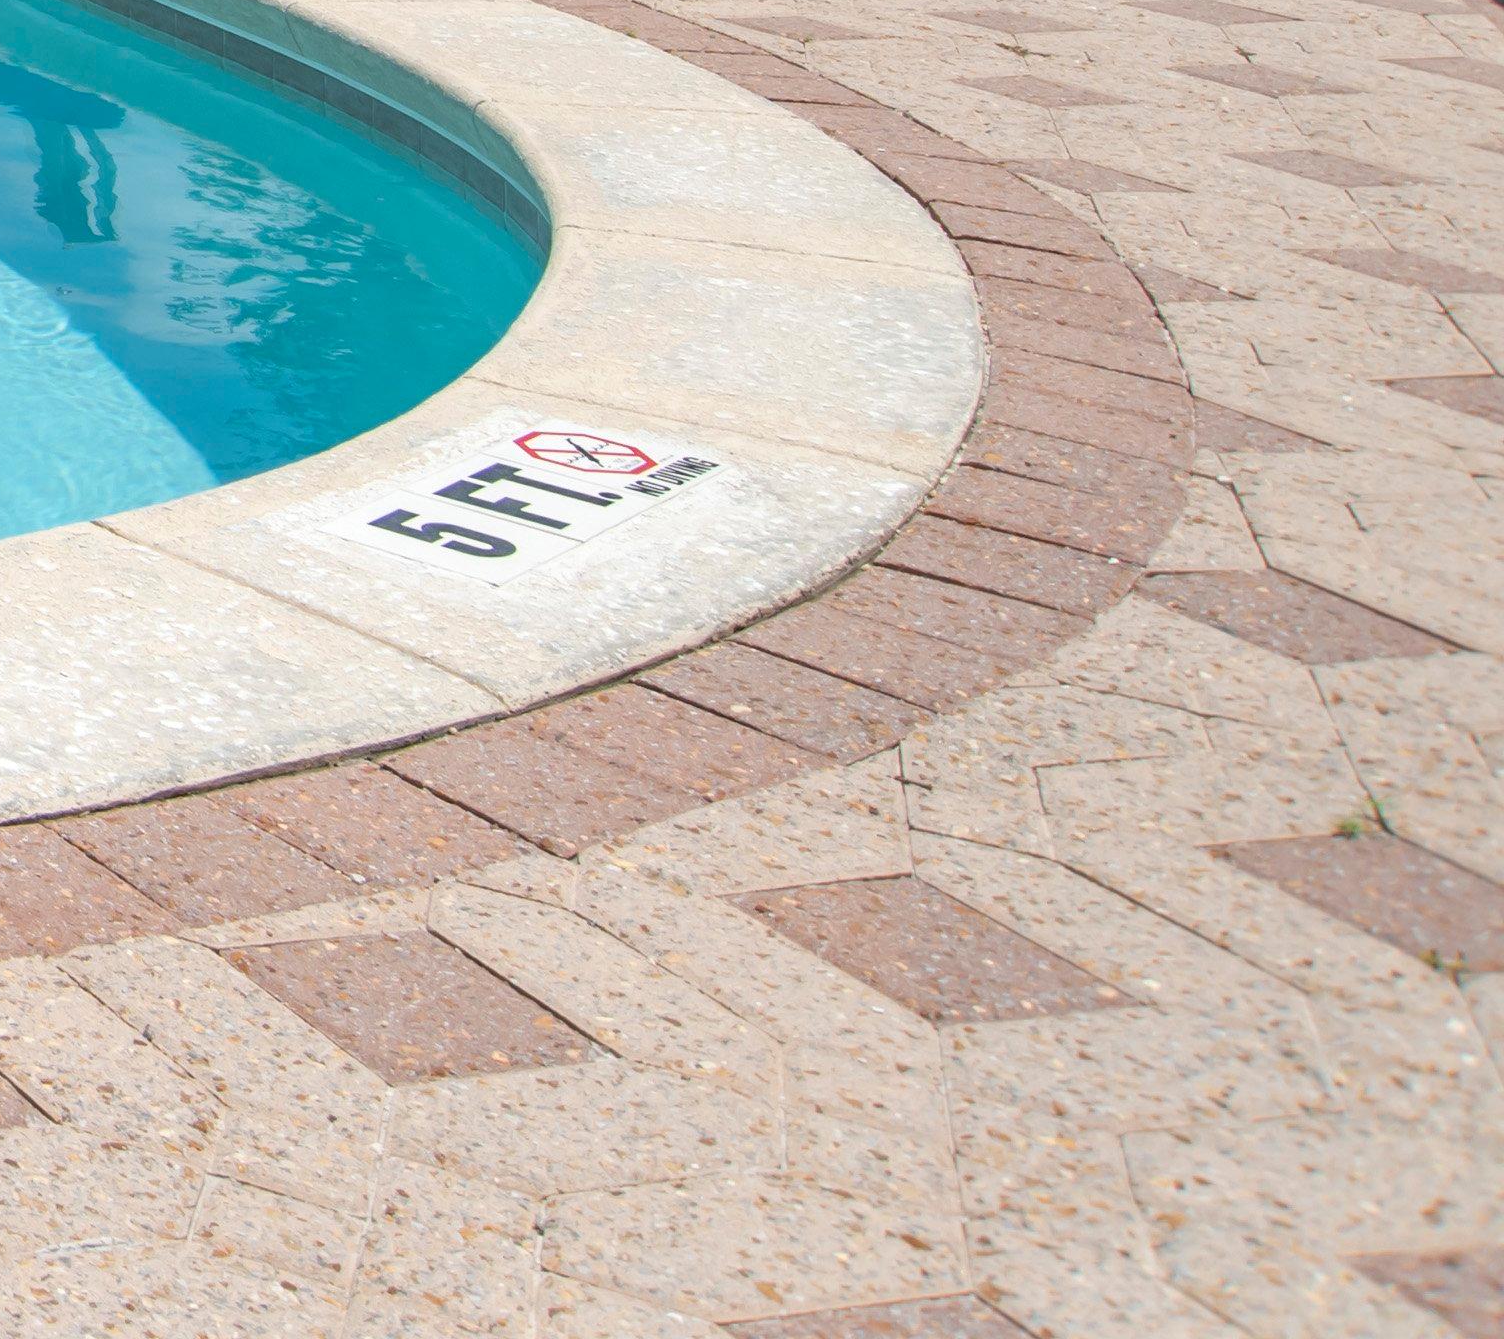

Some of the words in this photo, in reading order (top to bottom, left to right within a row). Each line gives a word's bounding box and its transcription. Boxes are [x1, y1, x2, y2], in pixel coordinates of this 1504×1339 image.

[647, 457, 719, 485] DIVING
[624, 480, 671, 497] NO
[367, 509, 517, 558] 5
